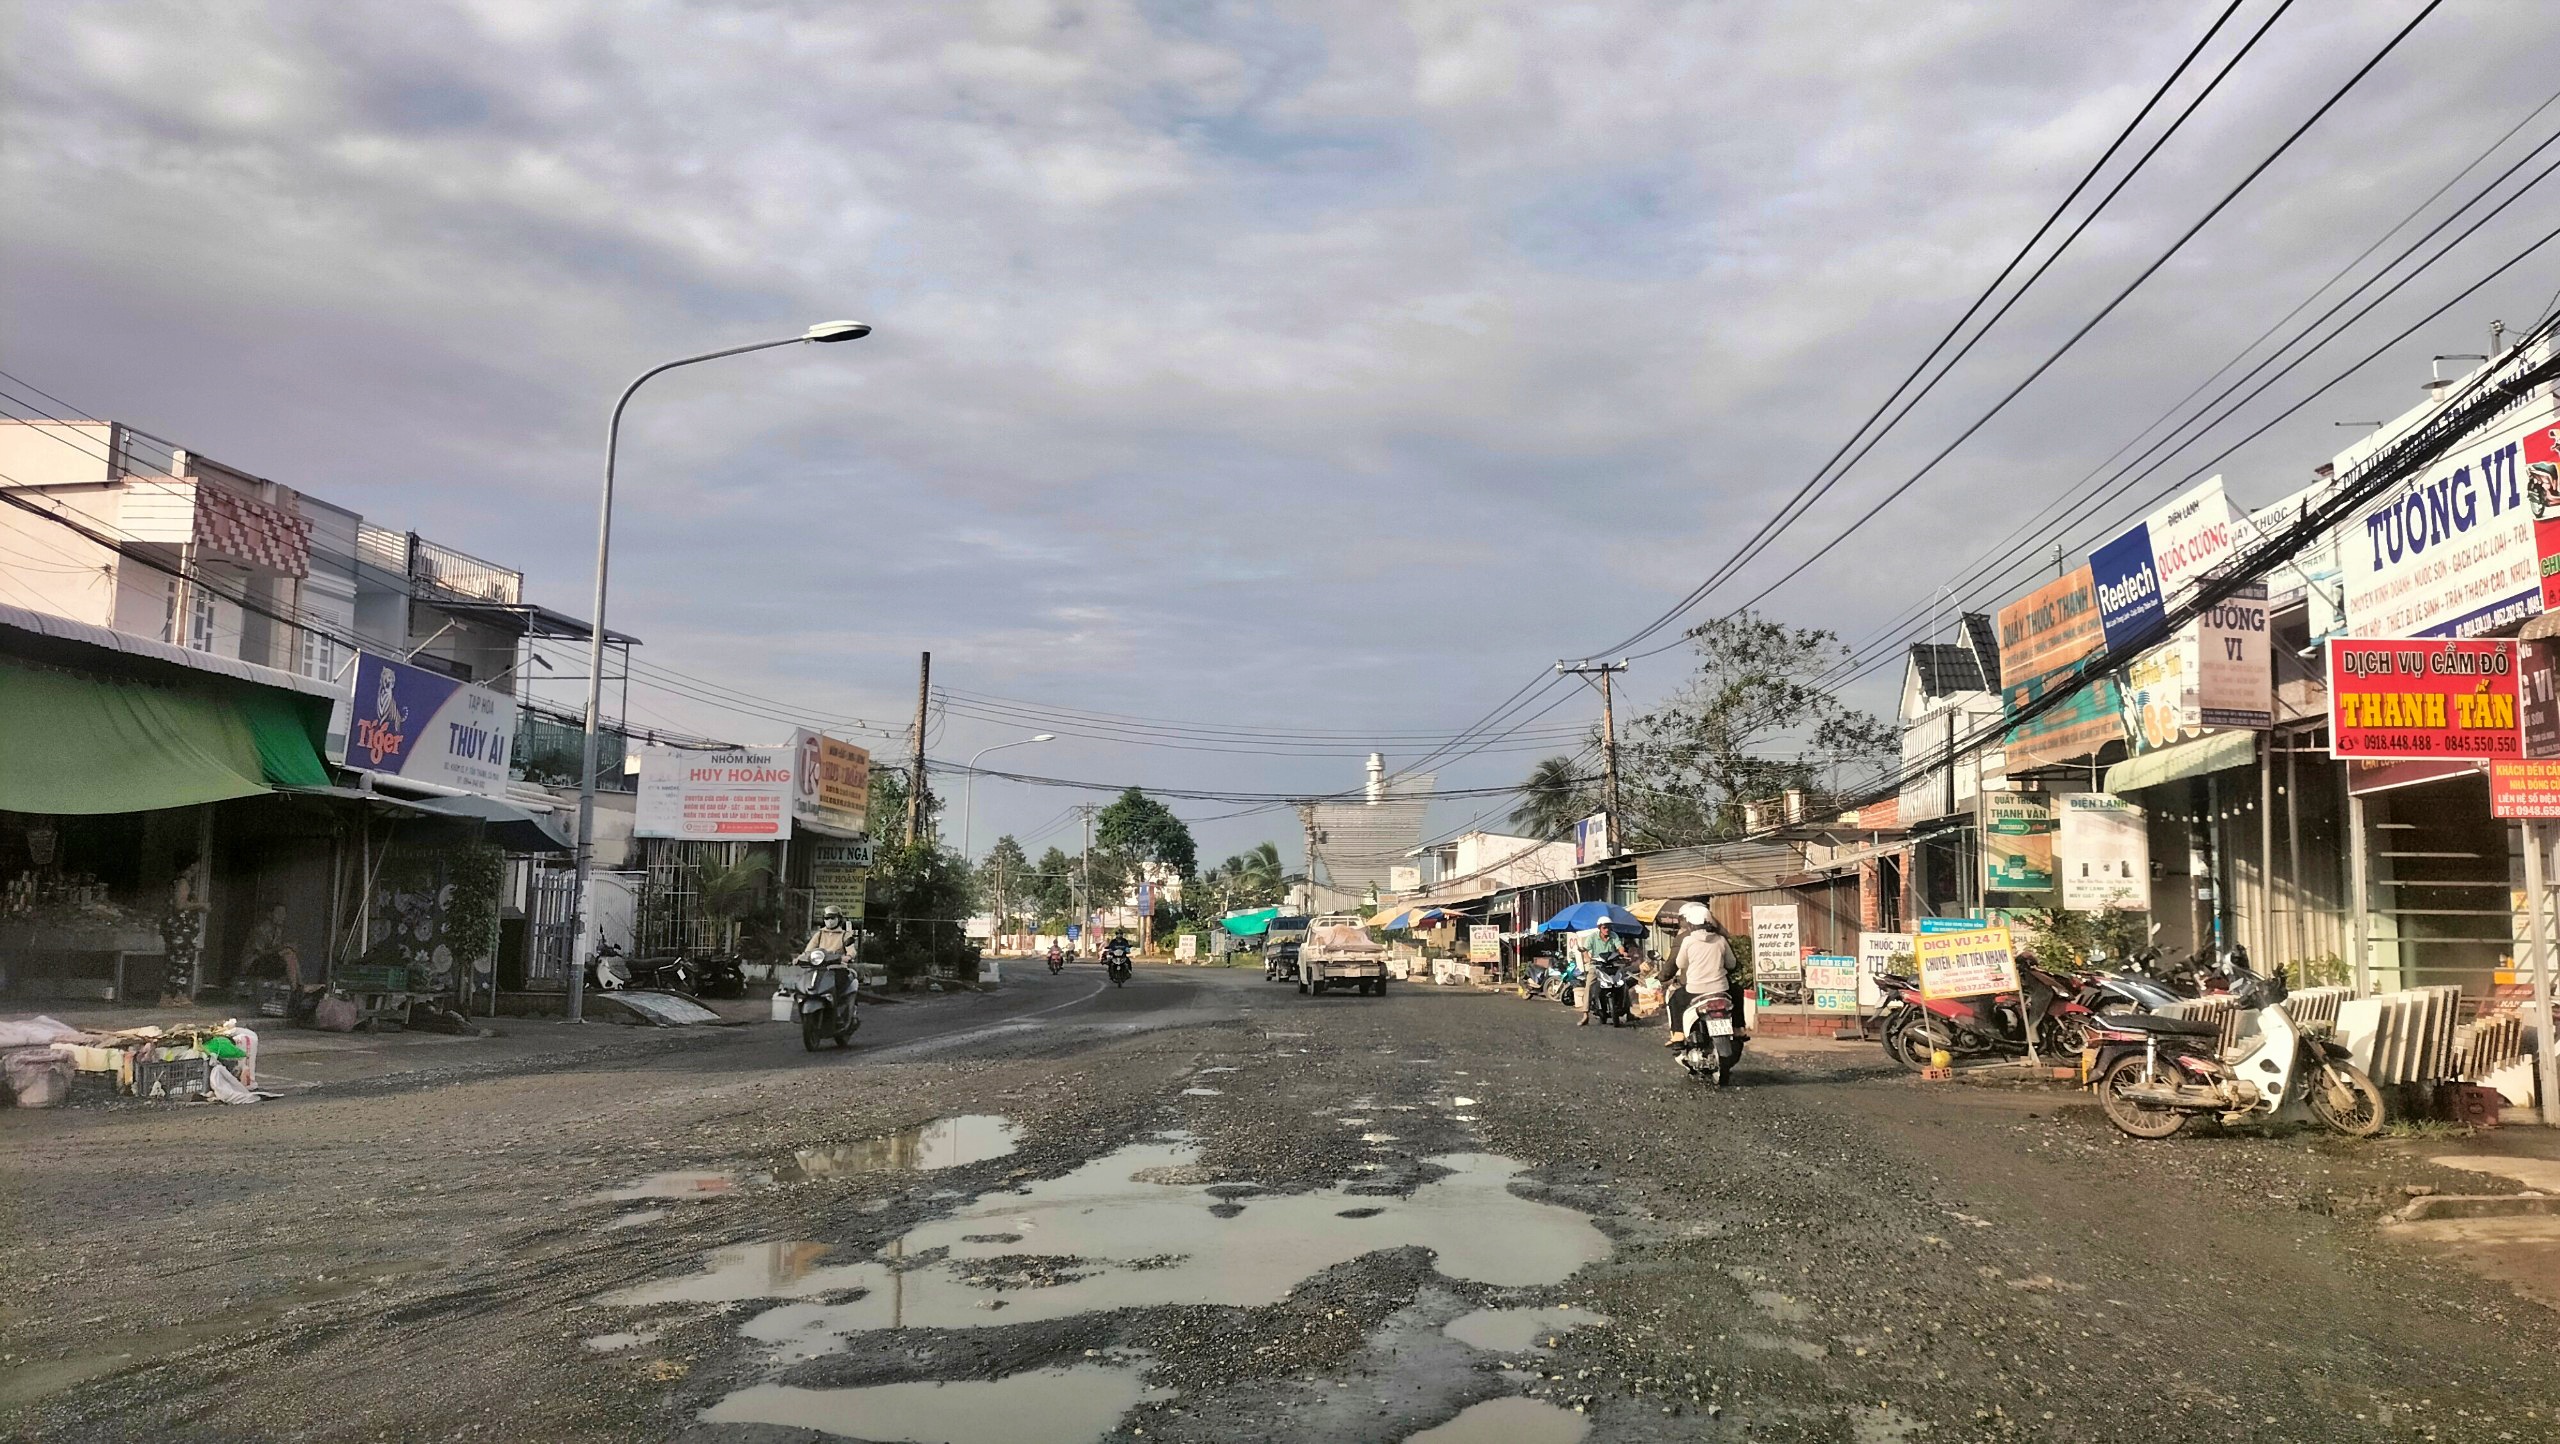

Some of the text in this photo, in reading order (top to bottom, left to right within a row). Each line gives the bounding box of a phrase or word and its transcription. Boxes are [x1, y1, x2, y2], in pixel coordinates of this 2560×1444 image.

[2367, 441, 2521, 572] TƯỜNG VI
[2098, 561, 2156, 616] Reetech
[2224, 637, 2243, 661] VI
[2343, 642, 2509, 679] DỊCH VỤ CẦM ĐỒ
[2340, 679, 2515, 729] THANH TẤN
[357, 718, 404, 765] Tiger
[449, 720, 505, 766] THÚY ÁI
[2364, 734, 2432, 751] 0918.448.488
[2445, 736, 2517, 753] 0845.550.550
[746, 753, 772, 764] KÍNH
[690, 765, 791, 783] HUY HOÀNG
[2496, 762, 2525, 776] KHÁCH
[1990, 808, 2024, 818] THANH
[2099, 799, 2129, 810] LẠNH
[846, 847, 869, 861] NGA
[1782, 930, 1795, 939] TỐ
[1985, 948, 2009, 966] NHANH
[1810, 968, 1831, 986] 45
[1835, 976, 1854, 986] 000
[1817, 995, 1856, 1008] 95 000
